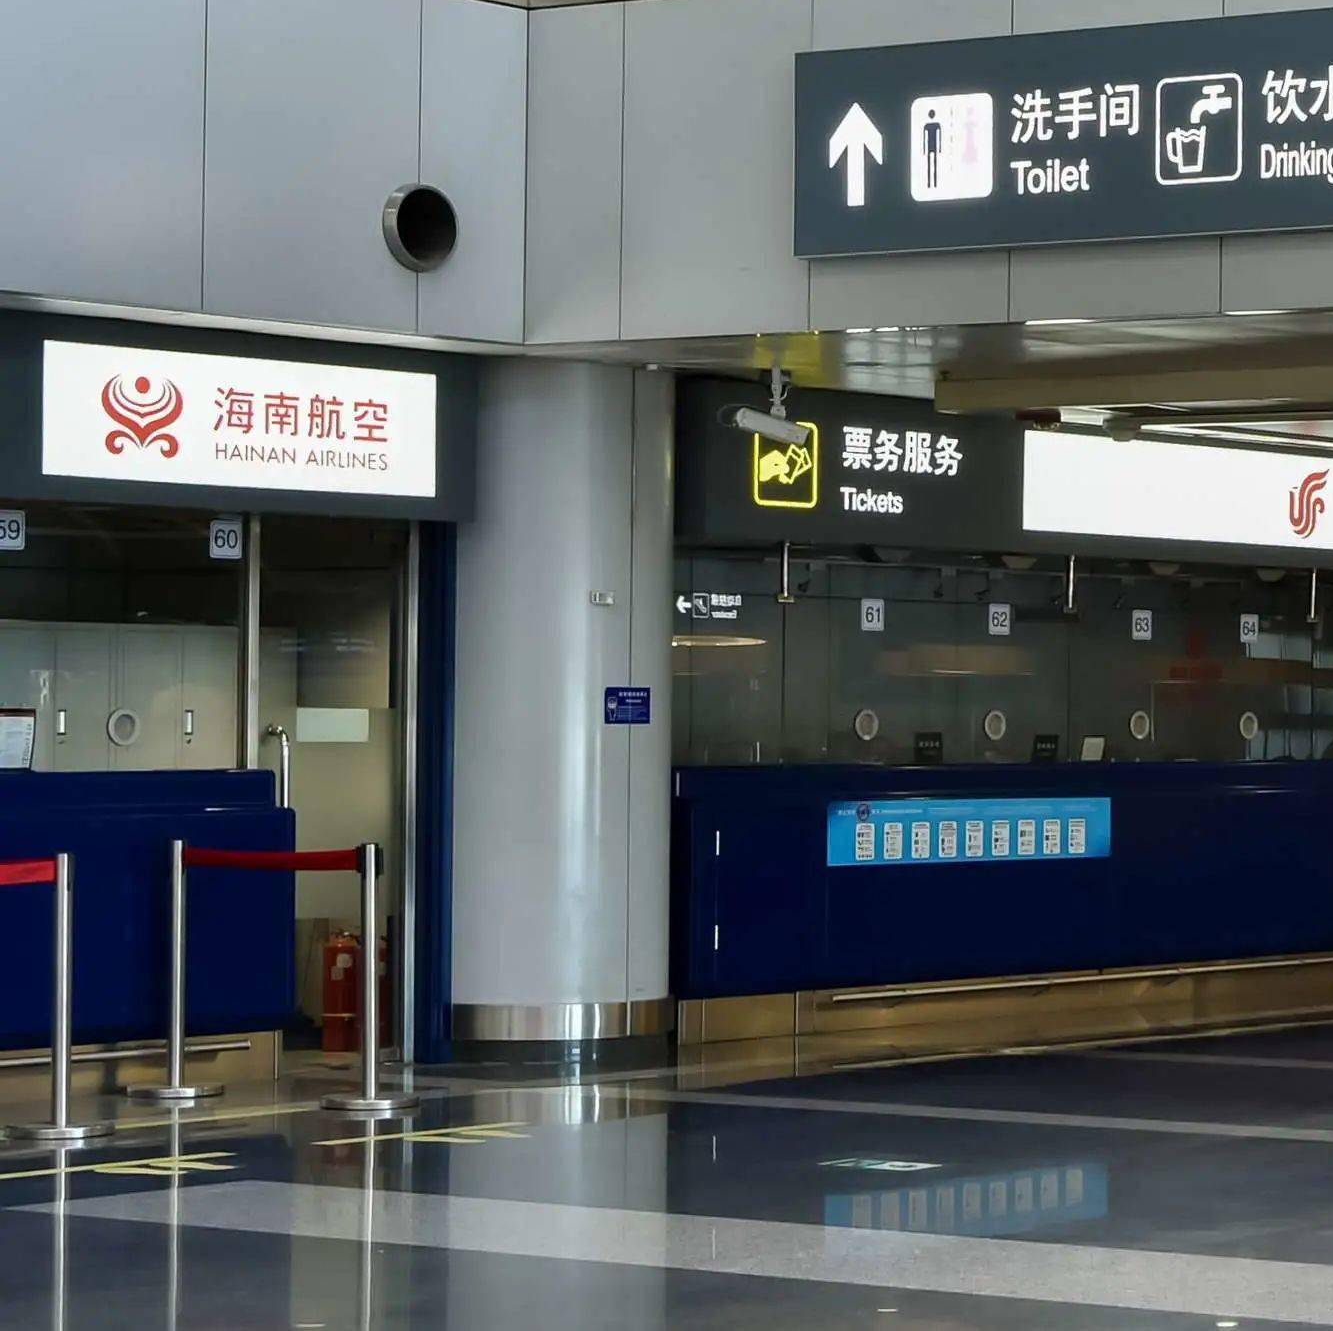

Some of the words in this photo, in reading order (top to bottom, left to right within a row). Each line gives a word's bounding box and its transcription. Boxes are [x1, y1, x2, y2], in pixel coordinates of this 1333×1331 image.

[1010, 83, 1142, 145] 洗手间
[1010, 157, 1091, 196] Toilet
[213, 387, 388, 443] 海南航空
[215, 442, 296, 466] HAINAN
[305, 449, 389, 472] AIRLINES
[842, 425, 964, 477] 票务服务
[839, 486, 904, 514] Tickets
[214, 528, 238, 549] 60
[865, 606, 881, 623] 61
[992, 611, 1008, 627] 62
[1135, 617, 1149, 633] 63
[1242, 621, 1256, 635] 64
